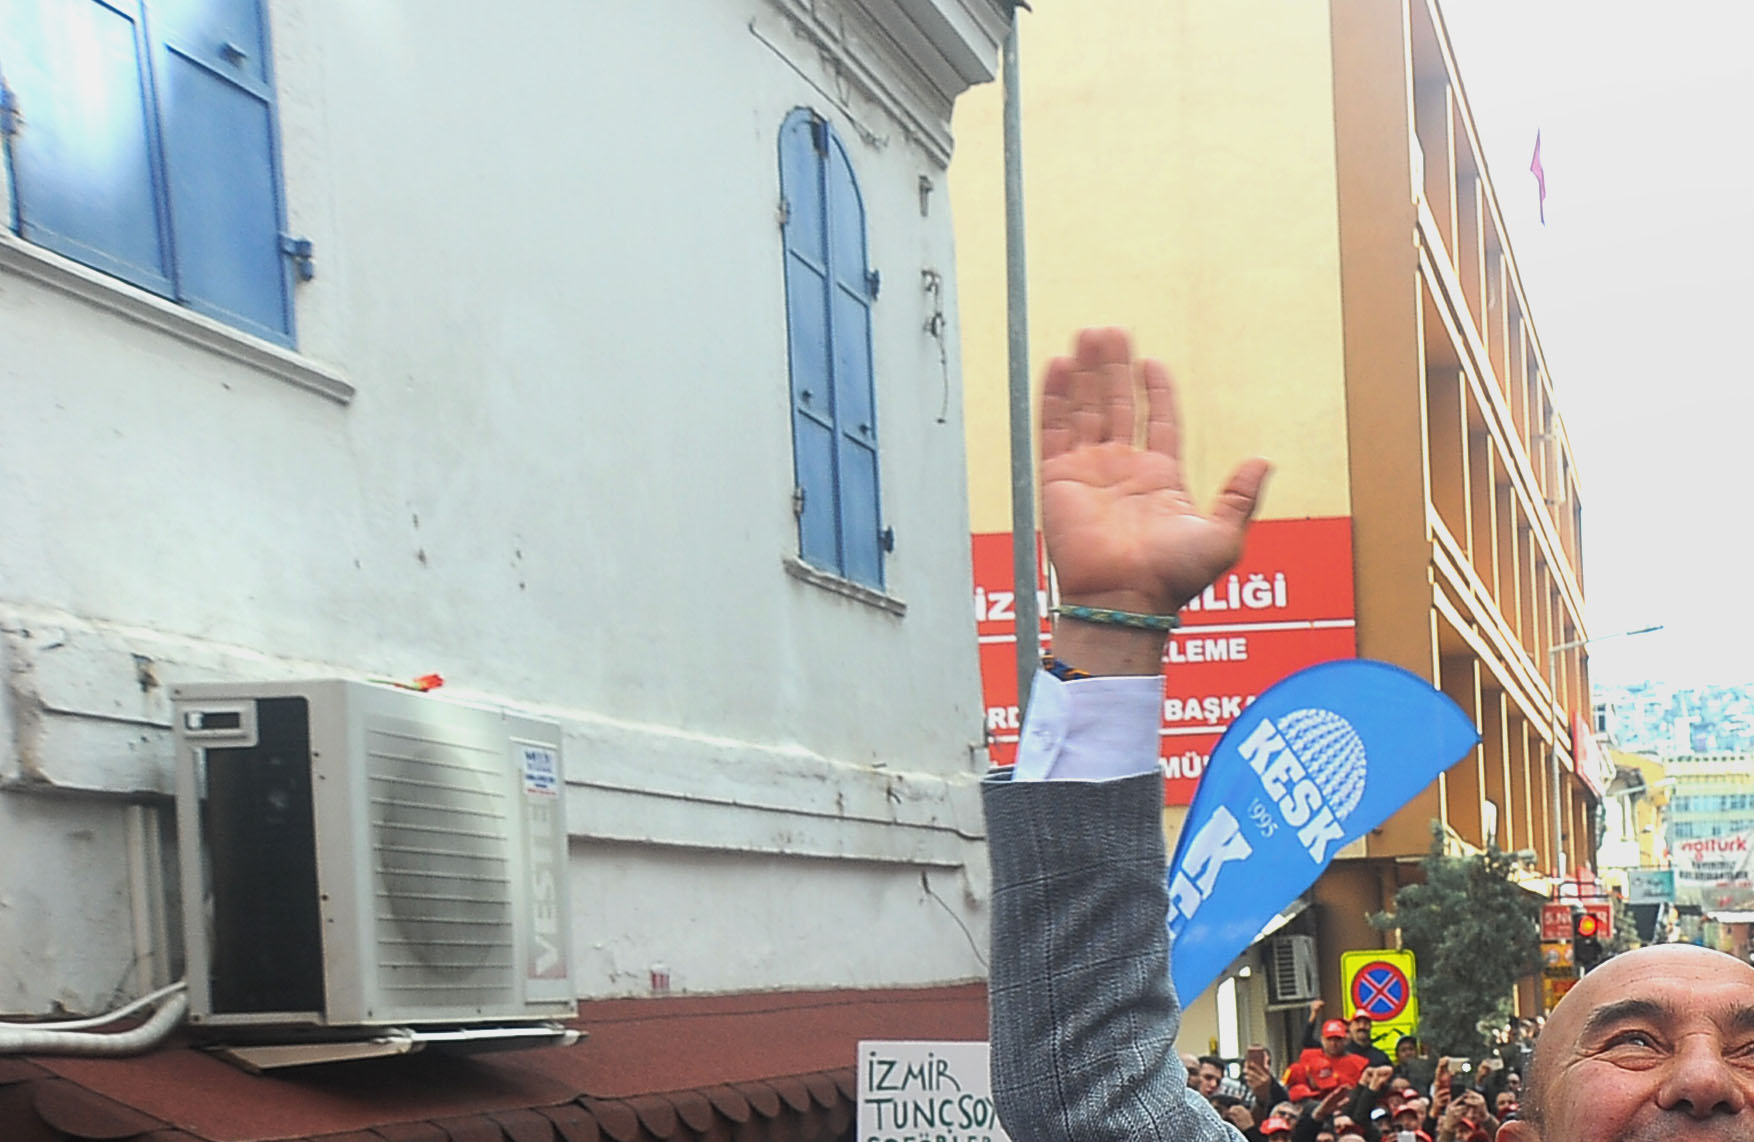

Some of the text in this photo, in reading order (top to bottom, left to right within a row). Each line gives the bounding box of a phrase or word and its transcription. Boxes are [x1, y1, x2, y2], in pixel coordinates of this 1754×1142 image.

[1163, 637, 1248, 664] LEME
[1237, 717, 1346, 865] KESK
[1248, 797, 1281, 839] 1995
[868, 1051, 961, 1092] İZMİR
